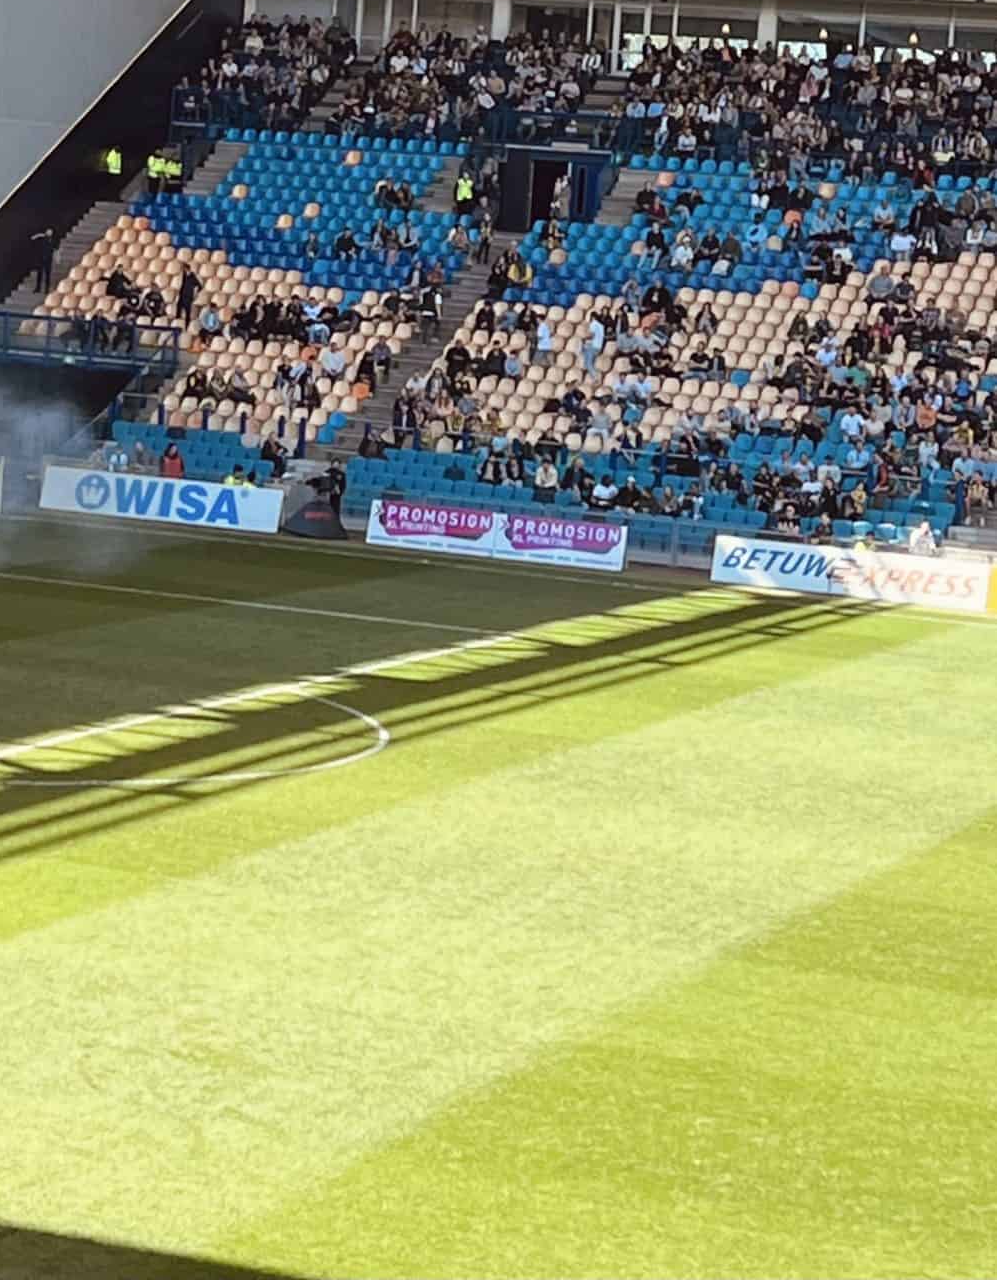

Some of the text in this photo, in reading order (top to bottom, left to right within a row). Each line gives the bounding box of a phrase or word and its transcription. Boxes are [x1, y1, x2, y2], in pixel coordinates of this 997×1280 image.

[115, 478, 239, 525] WISA
[387, 505, 491, 529] PROMOSIGN
[513, 519, 620, 543] PROMOSIGN
